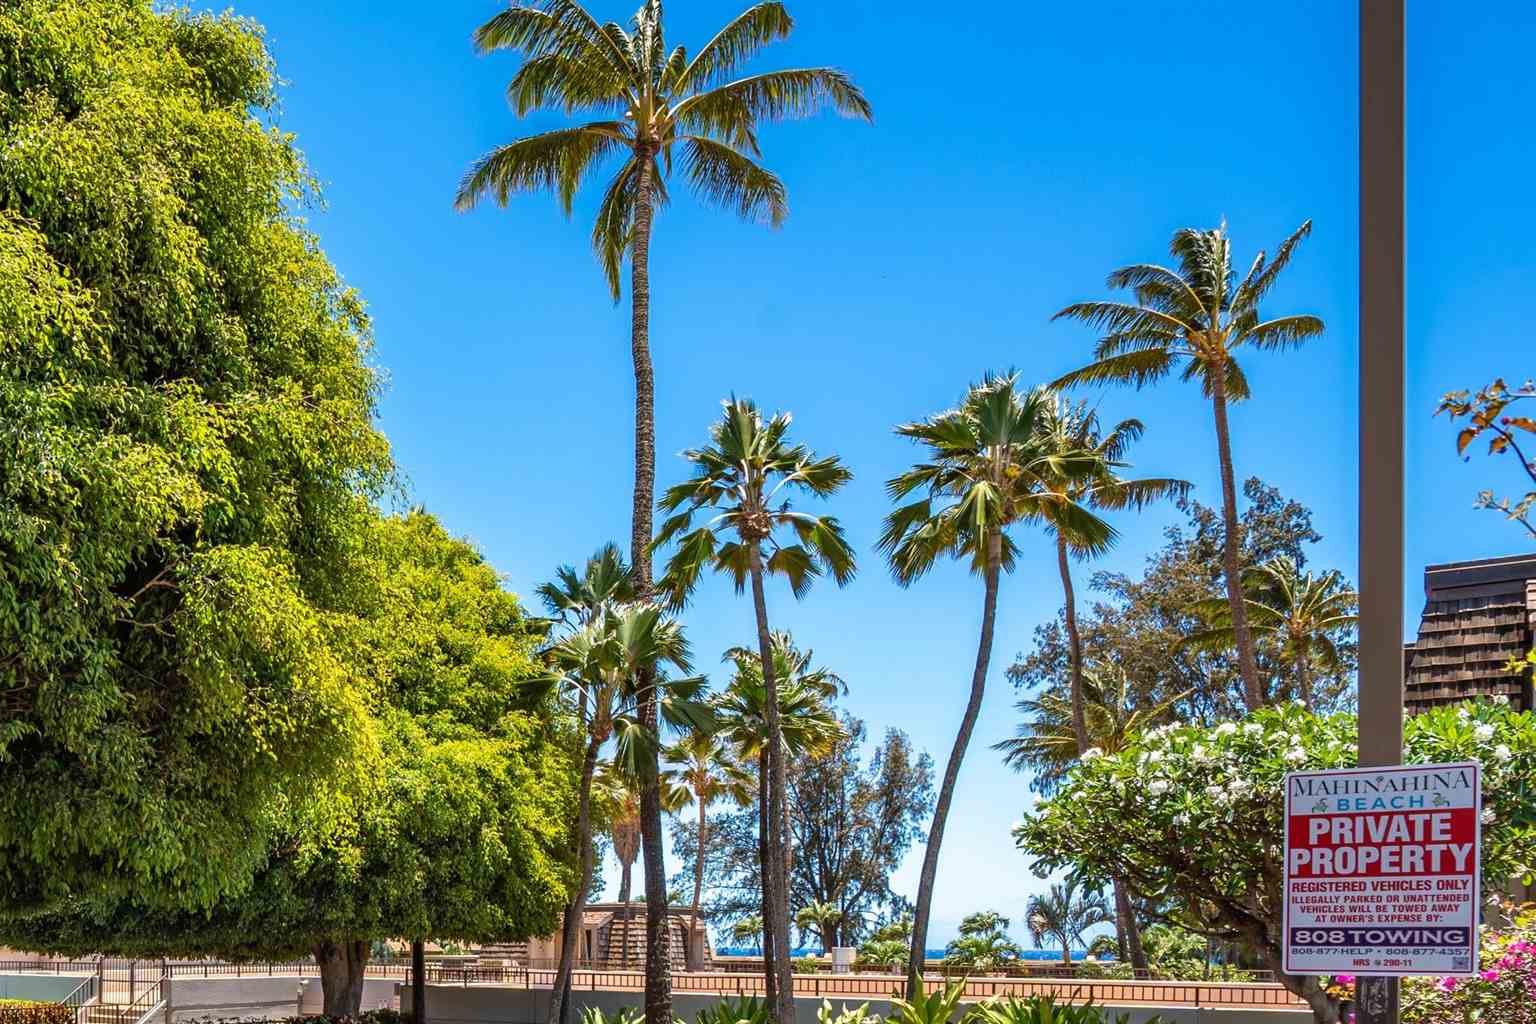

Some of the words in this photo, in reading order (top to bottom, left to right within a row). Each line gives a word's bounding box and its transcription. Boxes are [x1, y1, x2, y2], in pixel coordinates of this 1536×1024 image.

[1337, 795, 1425, 812] BEACH
[1308, 812, 1453, 846] PRIVATE
[1289, 842, 1474, 876] PROPERTY
[1291, 880, 1367, 893] REGISTERED
[1371, 880, 1433, 892] VEHICLES
[1436, 879, 1470, 891] ONLY
[1291, 895, 1341, 905] ILLEGALLY
[1343, 894, 1383, 904] PARKED
[1386, 894, 1401, 904] OR
[1403, 893, 1470, 903] UNATTENDED
[1299, 904, 1346, 914] VEHICLES
[1348, 904, 1372, 913] WILL
[1375, 904, 1389, 913] BE
[1392, 903, 1428, 913] TOWED
[1431, 903, 1461, 913] AWAY
[1315, 914, 1327, 923] AT
[1330, 914, 1375, 923] OWNER'S
[1377, 913, 1423, 923] EXPENSE
[1426, 913, 1445, 923] BY:
[1295, 930, 1346, 944] 808
[1348, 929, 1465, 944] TOWING
[1291, 947, 1374, 955] 808-877-HELP
